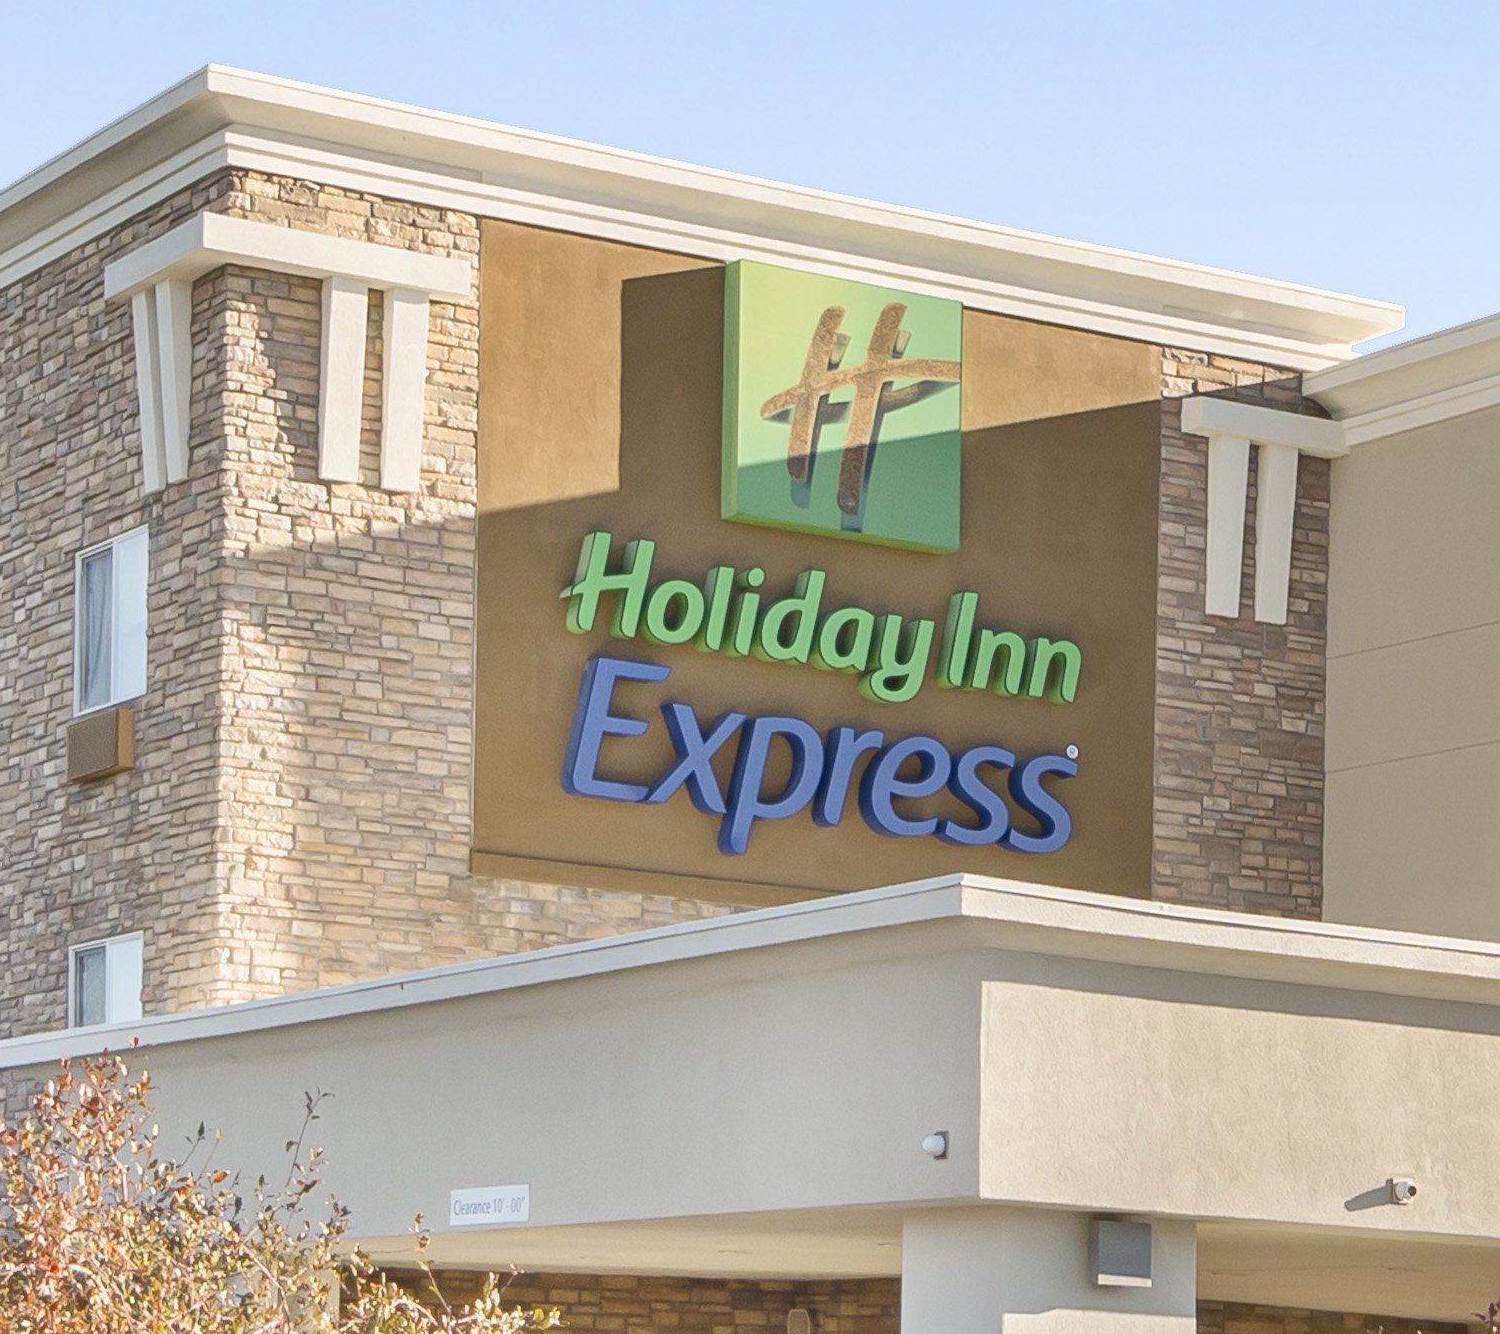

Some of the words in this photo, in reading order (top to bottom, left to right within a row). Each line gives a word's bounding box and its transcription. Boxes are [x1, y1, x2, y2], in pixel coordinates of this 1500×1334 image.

[560, 531, 935, 704] Holiday
[937, 591, 1083, 704] Inn
[561, 657, 1079, 855] Express
[453, 1200, 491, 1215] Clearance
